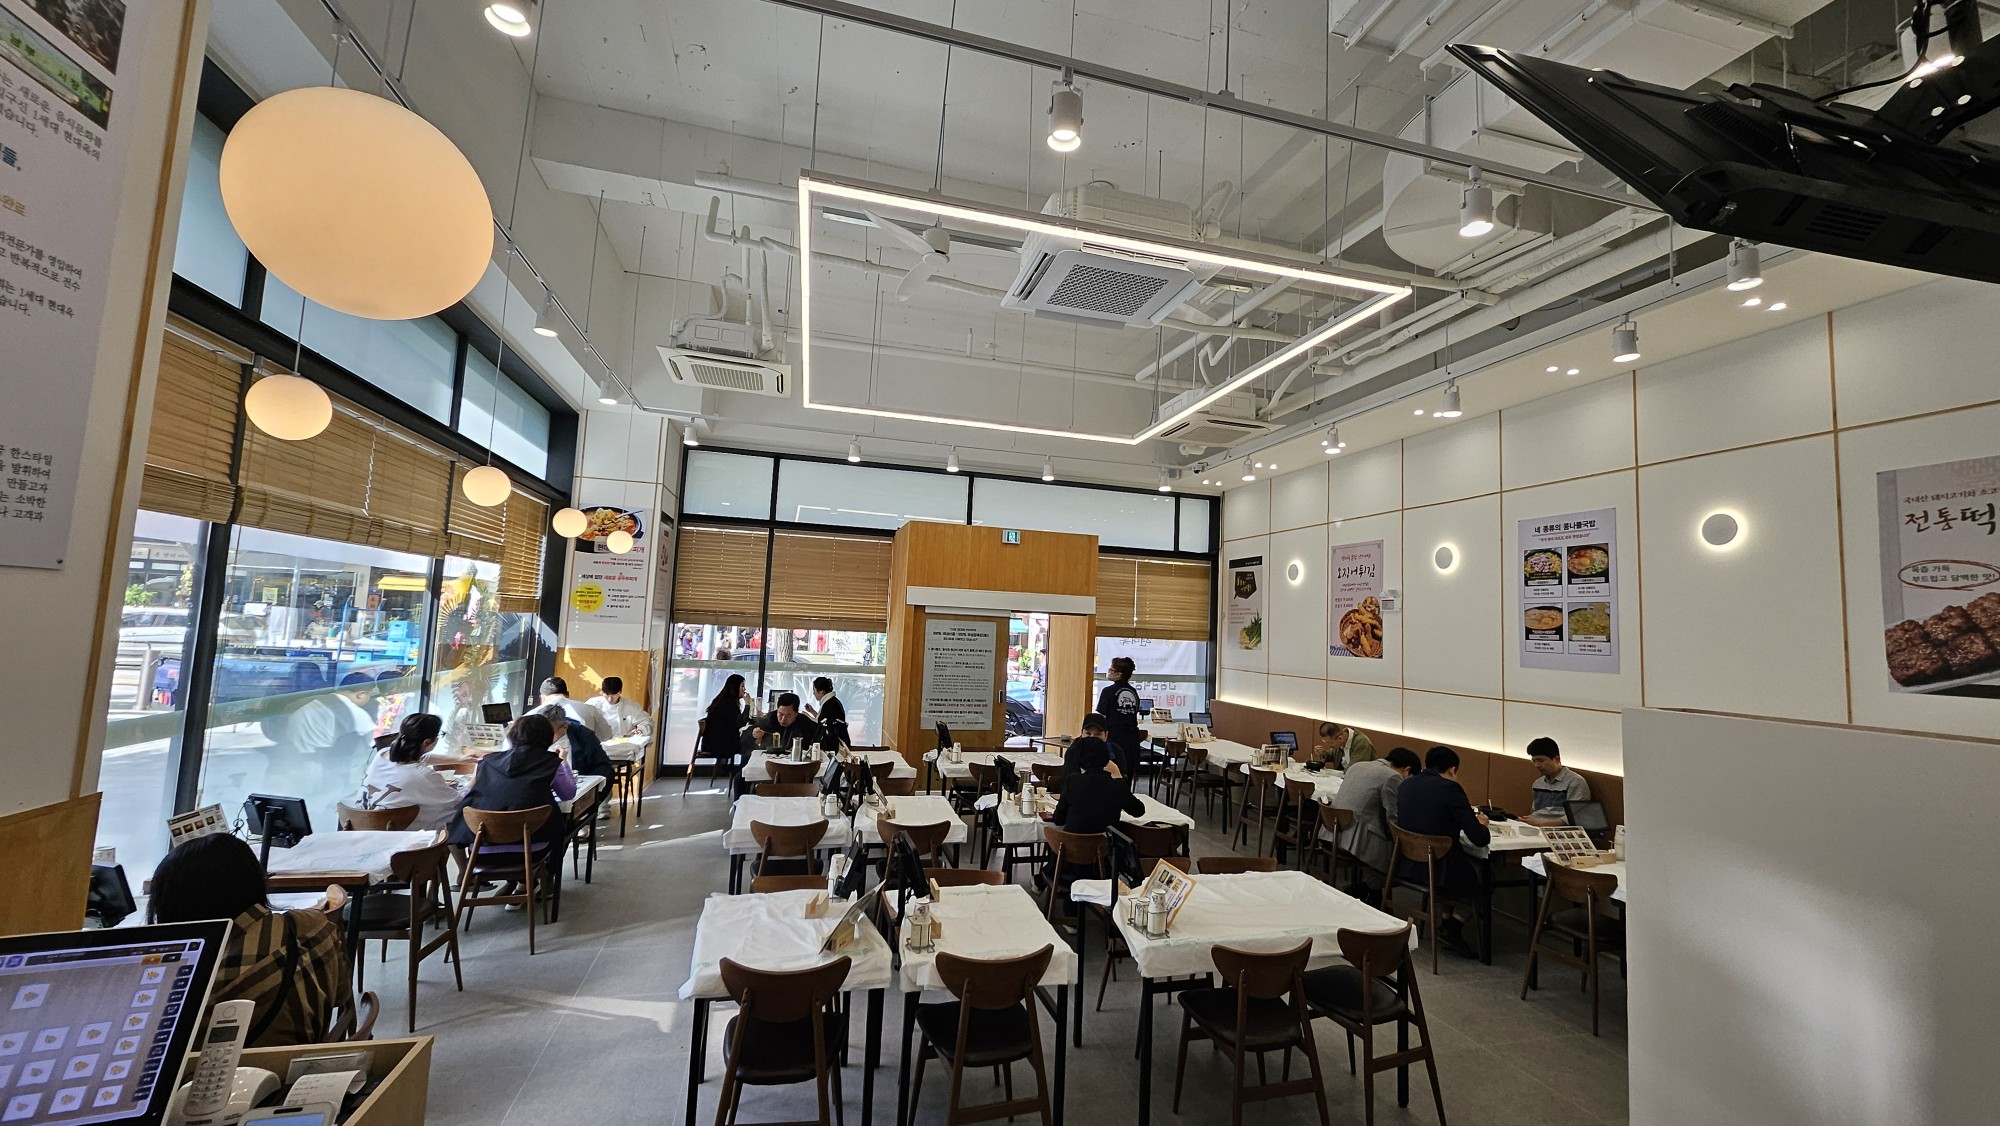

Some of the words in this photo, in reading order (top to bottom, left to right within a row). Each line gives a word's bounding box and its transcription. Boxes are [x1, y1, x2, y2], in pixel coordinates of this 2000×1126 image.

[18, 86, 51, 114] 새로운
[55, 110, 102, 149] 음식문화를
[33, 110, 60, 135] 1세대
[63, 130, 101, 161] 현대옥의
[10, 252, 60, 283] 반복적으로
[48, 255, 82, 280] 영입하여
[19, 288, 44, 306] 1세대
[48, 300, 75, 319] 현대옥
[10, 447, 53, 466] 한스타일
[11, 463, 51, 481] 발휘하여
[7, 478, 49, 494] 만들고자
[15, 494, 47, 509] 소박한
[1903, 493, 1929, 504] 국내산
[1931, 489, 1977, 501] 돼지고기와
[1979, 487, 2000, 496] 소고
[12, 509, 44, 523] 고객과
[1904, 503, 2000, 535] 전통떡
[1542, 524, 1561, 533] 종류의
[1563, 519, 1596, 531] 콩나물국밥
[1337, 563, 1376, 579] 오징어튀김
[1931, 565, 1950, 573] 가득
[1950, 574, 1979, 582] 담백한
